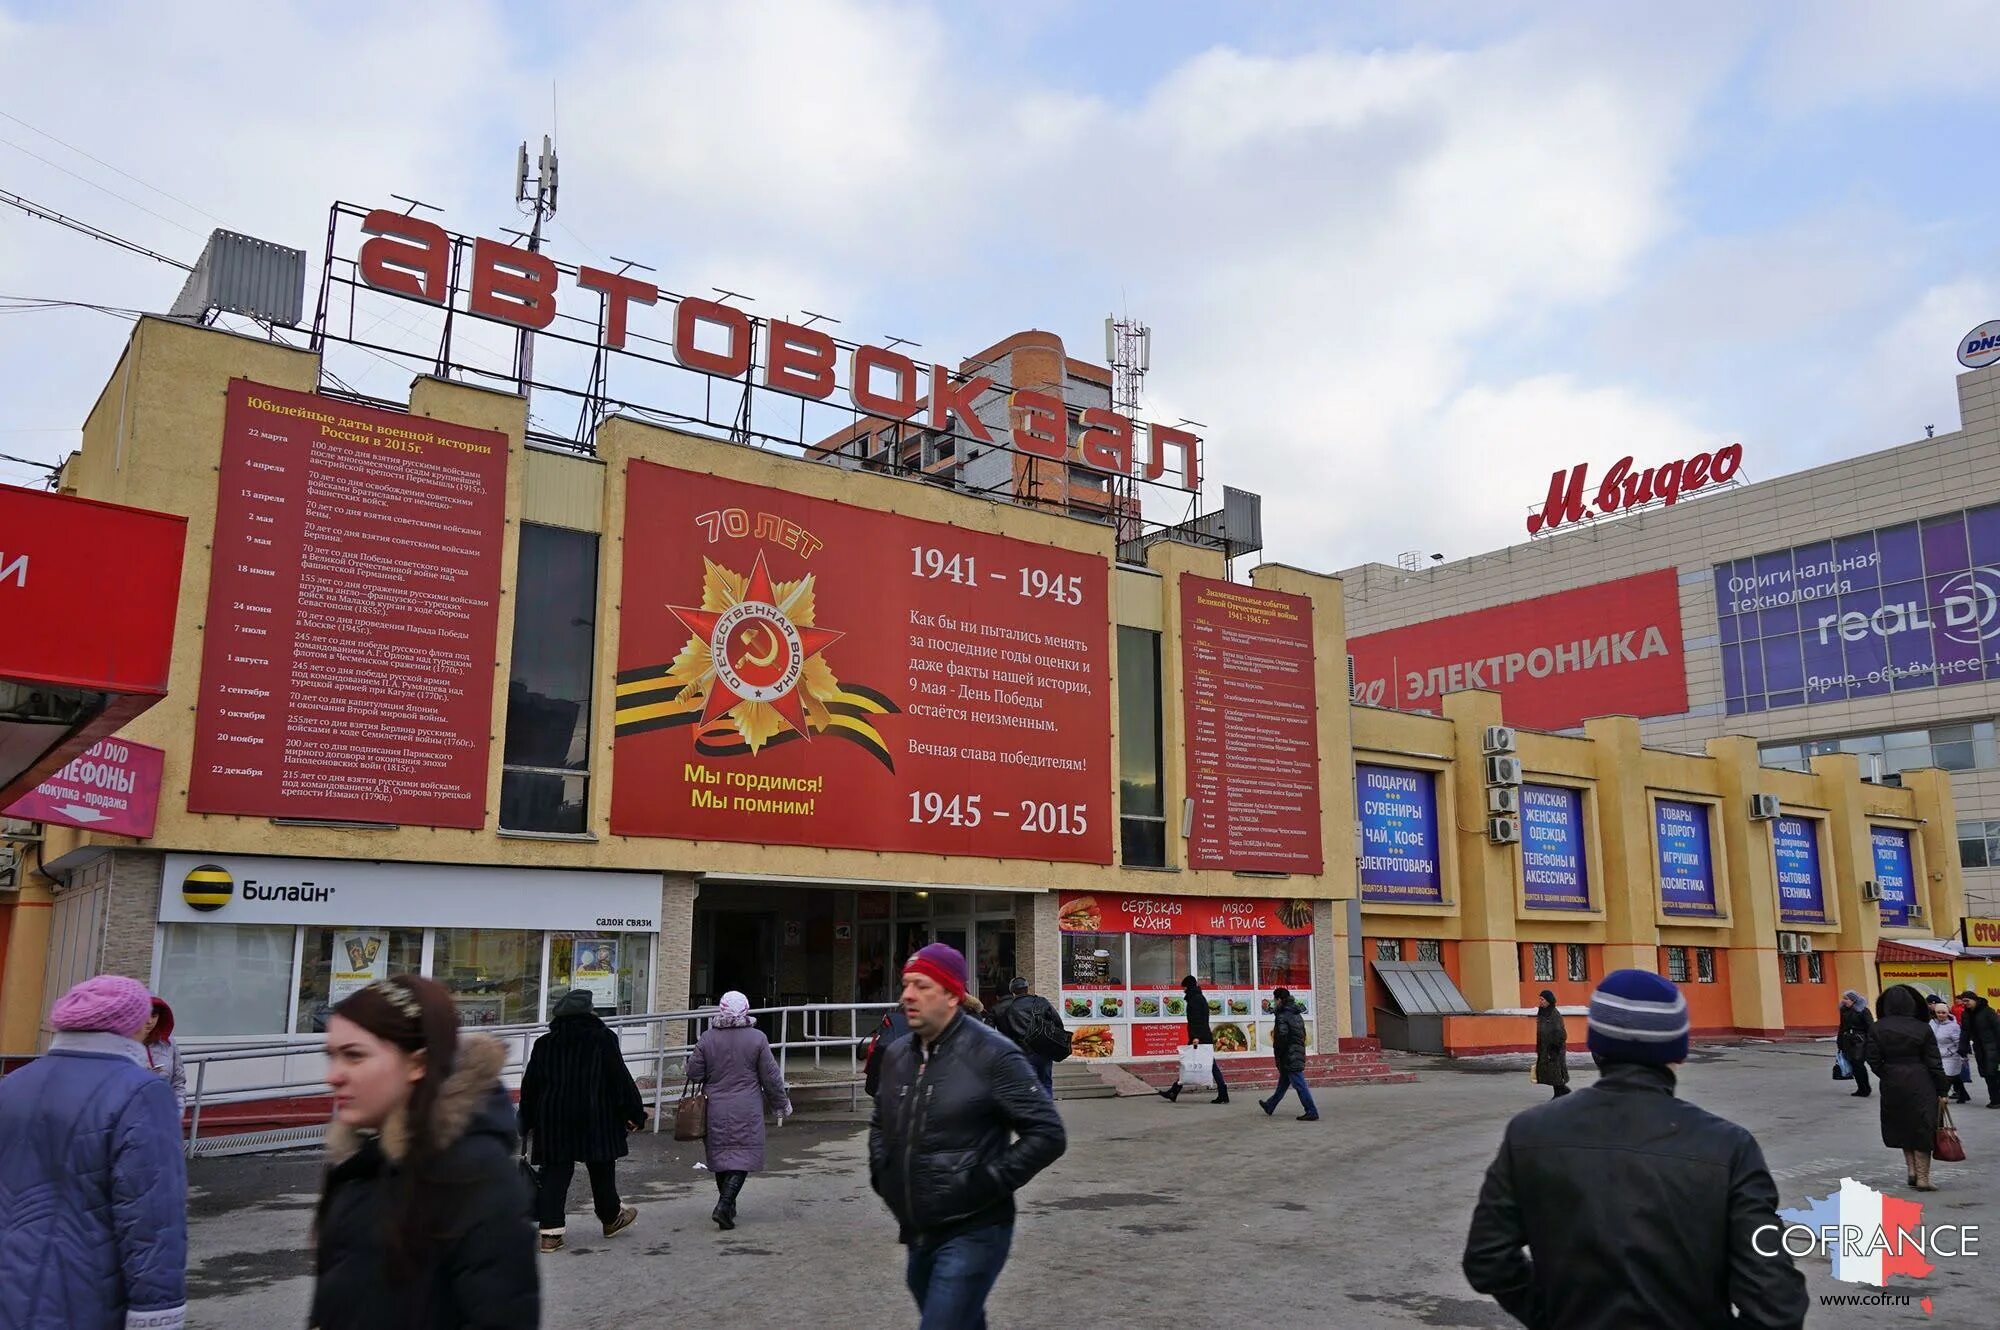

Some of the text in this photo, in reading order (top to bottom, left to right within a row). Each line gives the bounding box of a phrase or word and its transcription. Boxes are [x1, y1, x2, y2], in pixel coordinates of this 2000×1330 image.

[247, 396, 490, 453] Юбилейные даты военной истории
[247, 427, 288, 442] 22 марта
[321, 425, 423, 453] России в 2015г.
[252, 461, 284, 472] апреля
[241, 488, 284, 502] 13 апреля
[1527, 443, 1742, 534] М.видео
[248, 512, 273, 523] 2 мая
[245, 534, 271, 545] 9 мая
[695, 508, 824, 560] 70 ЛЕТ
[237, 564, 275, 576] 18 июня
[911, 546, 977, 587] 1941
[1019, 567, 1082, 605] 1945
[1728, 552, 1882, 594] Оригинальная
[1729, 579, 1852, 613] технология
[233, 601, 271, 613] 24 июня
[233, 623, 266, 635] 7 июля
[910, 609, 1088, 651] Как бы ни пытались менять
[227, 653, 268, 665] 1 августа
[909, 635, 1090, 673] за последние годы оценки и
[1405, 626, 1669, 701] ЭЛЕКТРОНИКА
[908, 657, 1091, 696] даже факты нашей истории,
[219, 684, 269, 697] 2 сентября
[908, 677, 918, 691] 9
[920, 682, 946, 695] мая
[958, 684, 991, 701] День
[993, 688, 1043, 709] Победы
[227, 710, 265, 720] октября
[908, 703, 1058, 731] остаётся неизменным.
[216, 732, 263, 744] 20 ноября
[104, 743, 128, 763] DVD
[908, 738, 1086, 771] Вечная слава победителям!
[53, 758, 136, 794] ЛЕФОНЫ
[211, 765, 262, 776] 22 декабря
[684, 763, 822, 792] Мы гордимся!
[1367, 774, 1417, 791] ПОДАРКИ
[691, 788, 814, 815] Мы помним!
[1523, 792, 1567, 808] МУЖСКАЯ
[909, 790, 981, 828] 1945
[1021, 800, 1087, 836] 2015
[1365, 801, 1422, 819] СУВЕНИРЫ
[1526, 809, 1568, 825] ЖЕНСКАЯ
[1662, 808, 1692, 822] ТОВАРЫ
[1365, 826, 1424, 846] ЧАЙ, КОФЕ
[1529, 826, 1567, 842] ОДЕЖДА
[1660, 823, 1696, 838] В ДОРОГУ
[1779, 822, 1801, 836] ФОТО
[1872, 834, 1905, 848] РИДИЧЕСКИЕ
[1360, 856, 1433, 874] ЭЛЕКТРОТОВАРЫ
[1524, 851, 1576, 868] ТЕЛЕФОНЫ И
[1663, 851, 1699, 866] ИГРУШКИ
[1526, 870, 1576, 885] АКСЕССУАРЫ
[1660, 877, 1705, 892] КОСМЕТИКА
[1779, 871, 1811, 885] БЫТОВАЯ
[1781, 886, 1812, 899] ТЕХНИКА
[1880, 889, 1905, 901] ДЕЖДА
[1121, 900, 1182, 915] СЕРБСКАЯ
[1222, 903, 1254, 913] МЯСО
[595, 918, 652, 927] салон связи
[1133, 915, 1171, 930] КУХНЯ
[1211, 916, 1266, 929] НА ГРИЛЕ
[1974, 922, 2000, 942] СТО
